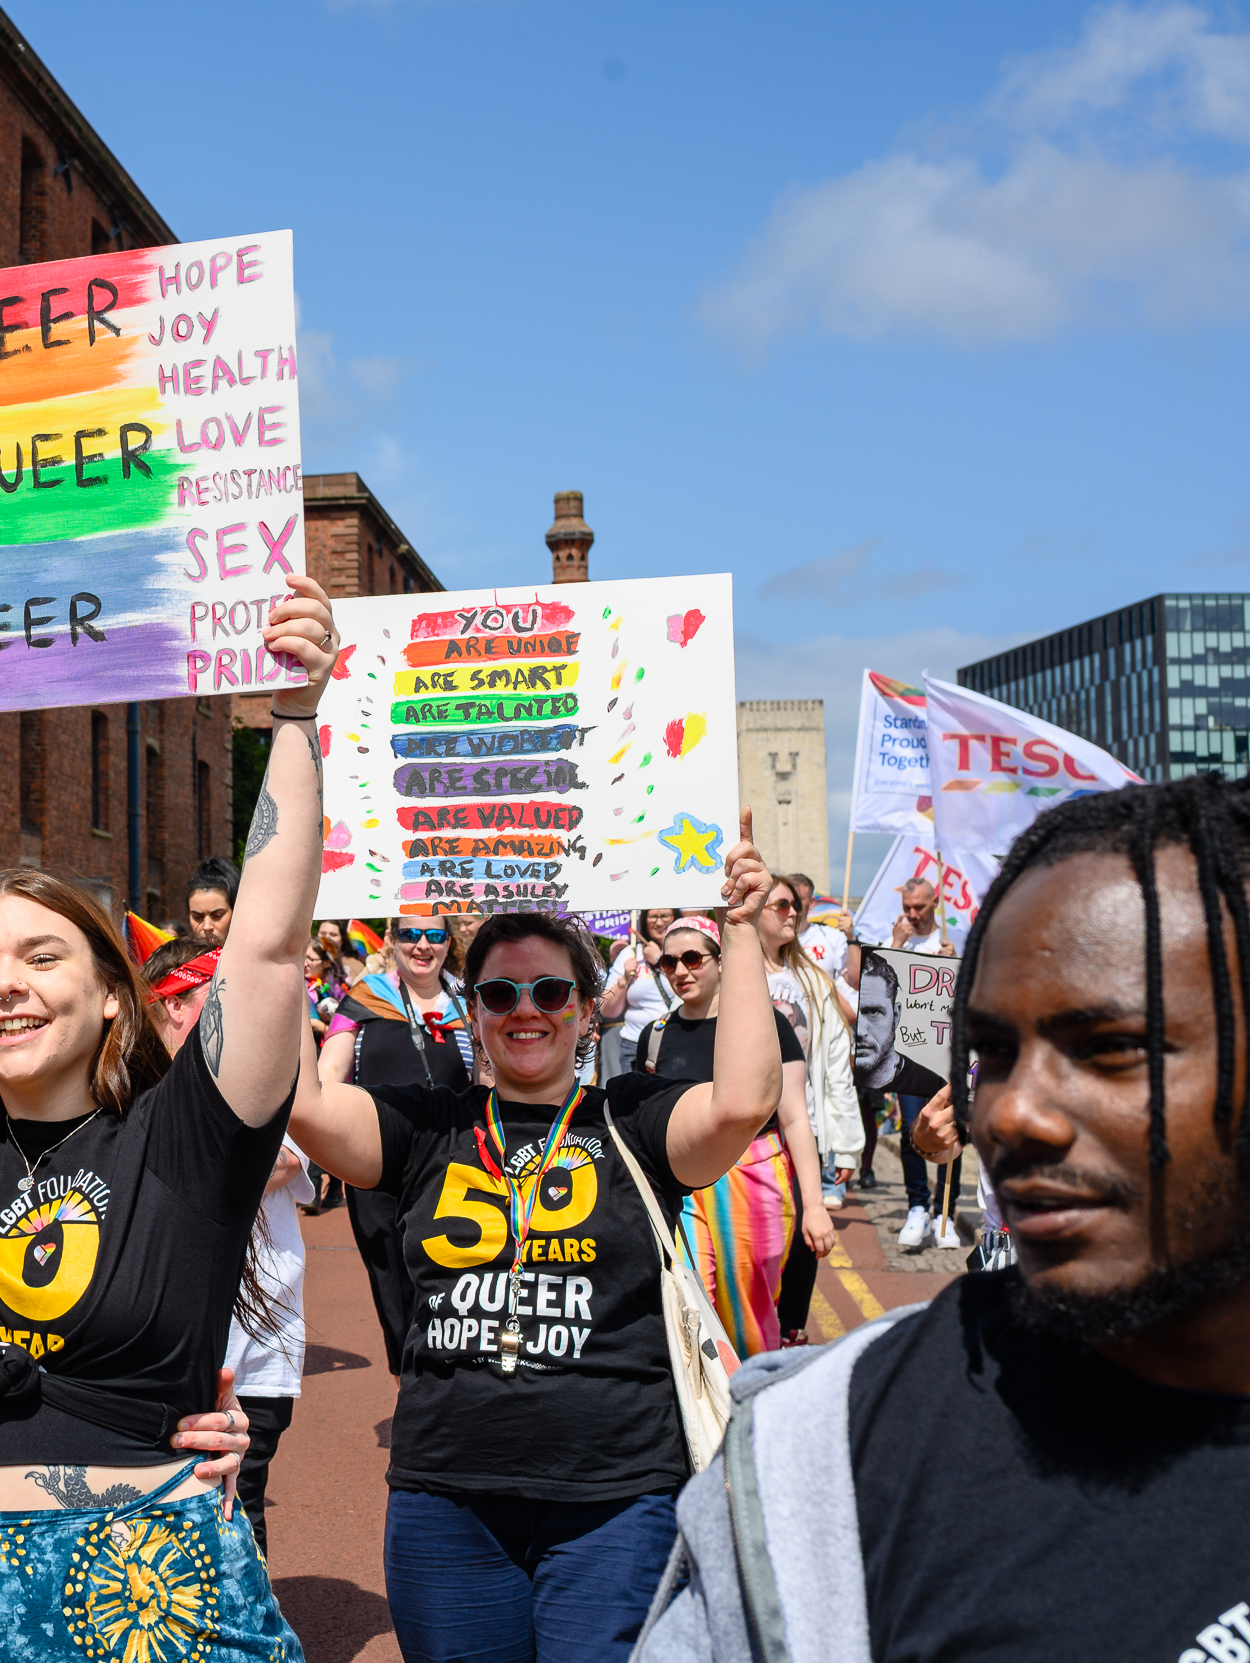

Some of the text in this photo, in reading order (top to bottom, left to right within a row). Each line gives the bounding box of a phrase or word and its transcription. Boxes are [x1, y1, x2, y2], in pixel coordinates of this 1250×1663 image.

[158, 245, 264, 298] HOPE
[147, 307, 222, 348] JOY
[157, 344, 296, 397] HEALTH
[175, 406, 287, 454] LOVE
[177, 463, 302, 508] RESISTANCE
[183, 513, 299, 584] SEX
[456, 605, 538, 635] YOU
[445, 636, 500, 660] ARE
[186, 645, 307, 692] PRIDE
[413, 664, 568, 693] ARE SMART
[404, 700, 450, 724] ARE
[405, 736, 461, 757] ARE
[881, 734, 927, 749] Proud
[405, 767, 469, 796] ARE
[412, 805, 584, 832] ARE VALUED
[408, 835, 587, 860] ARE AMAZING
[420, 861, 563, 882] ARE LOVED
[425, 879, 569, 899] ARE ASHLEY
[906, 998, 935, 1012] Won't
[504, 1143, 537, 1176] LGBT
[421, 1162, 597, 1269] 50
[521, 1238, 597, 1263] YEARS
[428, 1272, 593, 1321] OF QUEER
[427, 1317, 591, 1359] HOPE JOY
